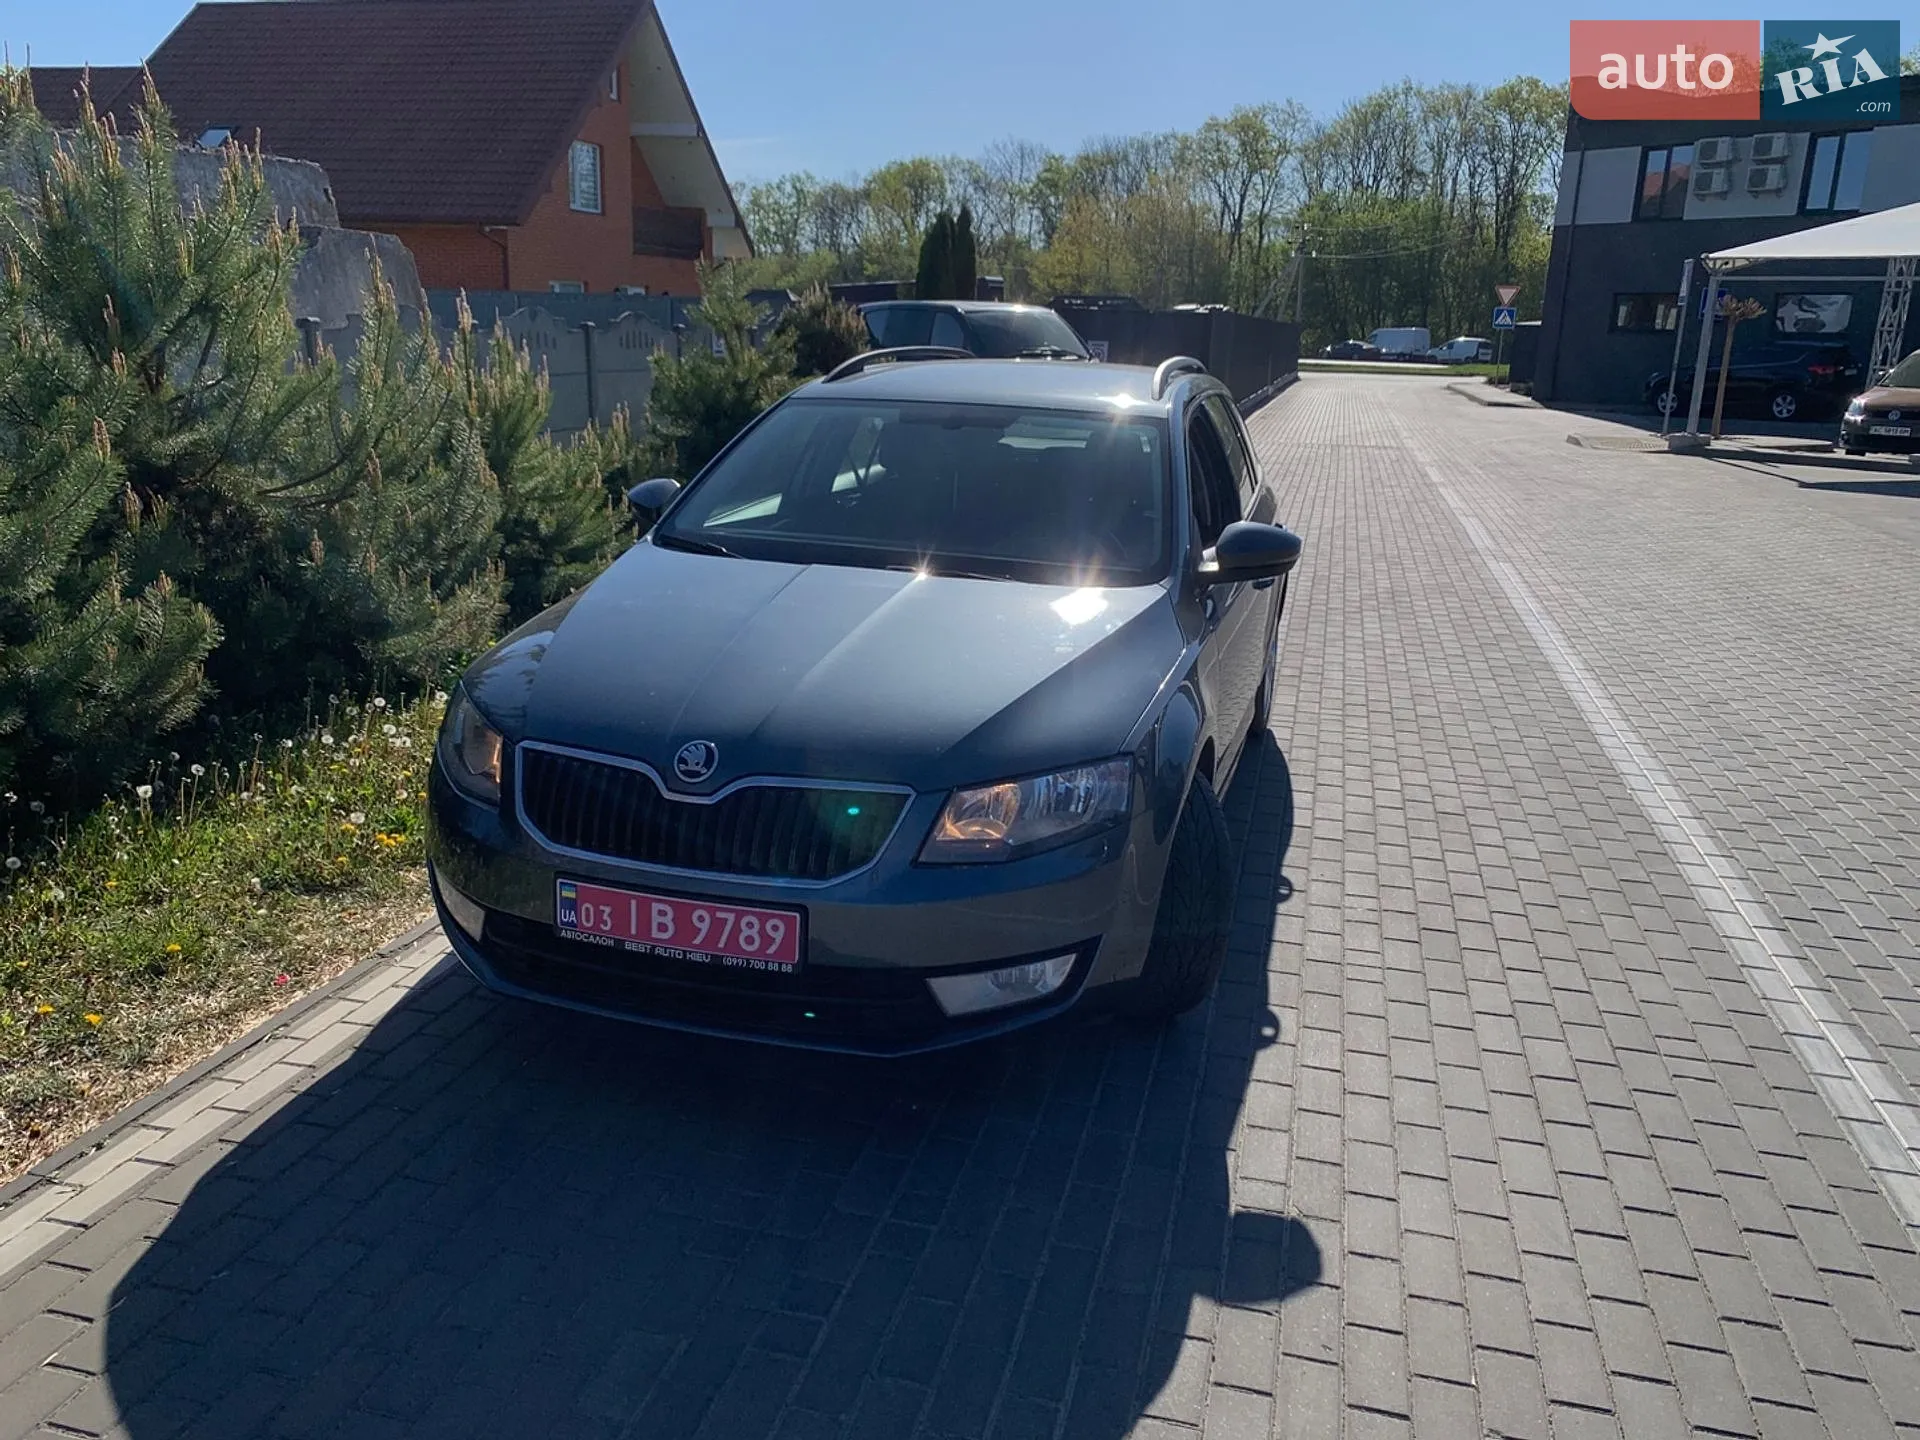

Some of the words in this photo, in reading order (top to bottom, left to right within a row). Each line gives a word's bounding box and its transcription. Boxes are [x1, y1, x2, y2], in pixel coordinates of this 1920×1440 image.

[561, 907, 577, 924] UA
[581, 902, 612, 931] 03
[691, 908, 785, 955] 9789
[624, 941, 651, 953] BEST
[655, 946, 683, 959] AUTO
[749, 960, 765, 970] 700
